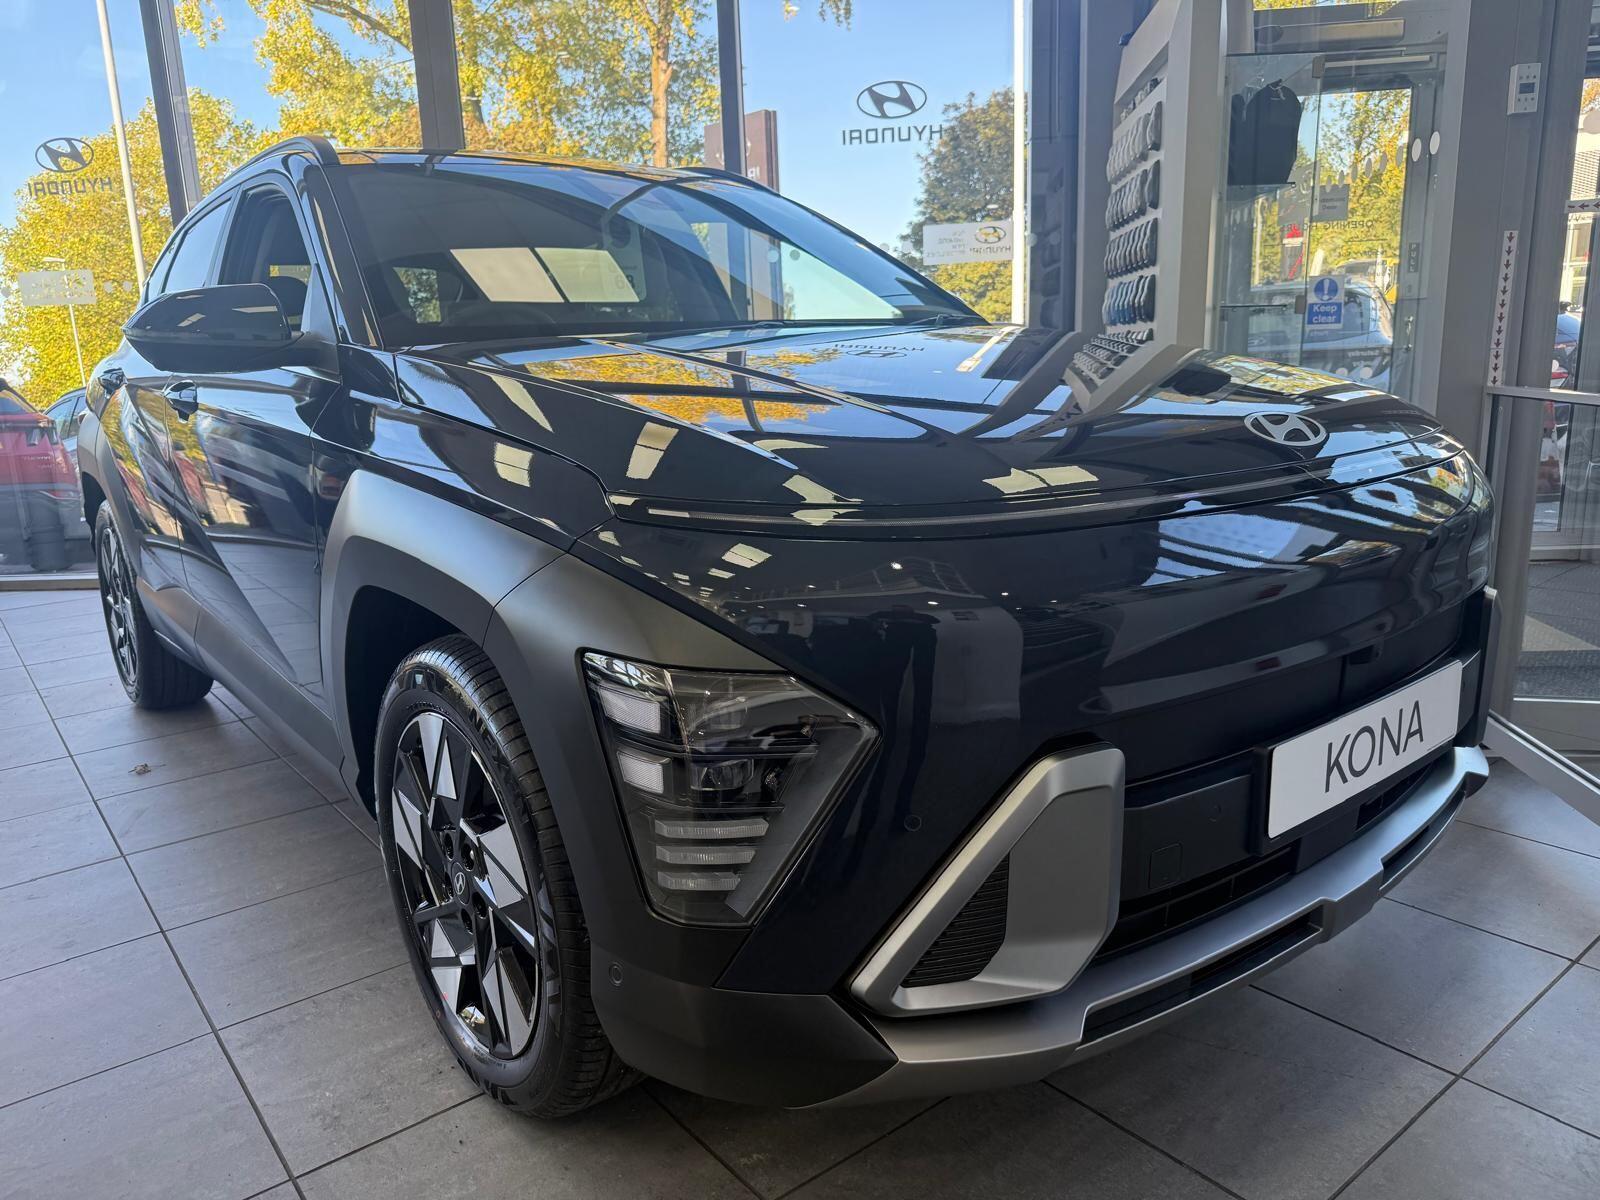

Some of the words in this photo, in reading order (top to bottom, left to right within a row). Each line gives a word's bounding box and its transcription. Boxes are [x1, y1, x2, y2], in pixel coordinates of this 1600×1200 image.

[1312, 304, 1337, 315] Keep
[1312, 313, 1337, 323] clear
[1324, 699, 1424, 793] KONA
